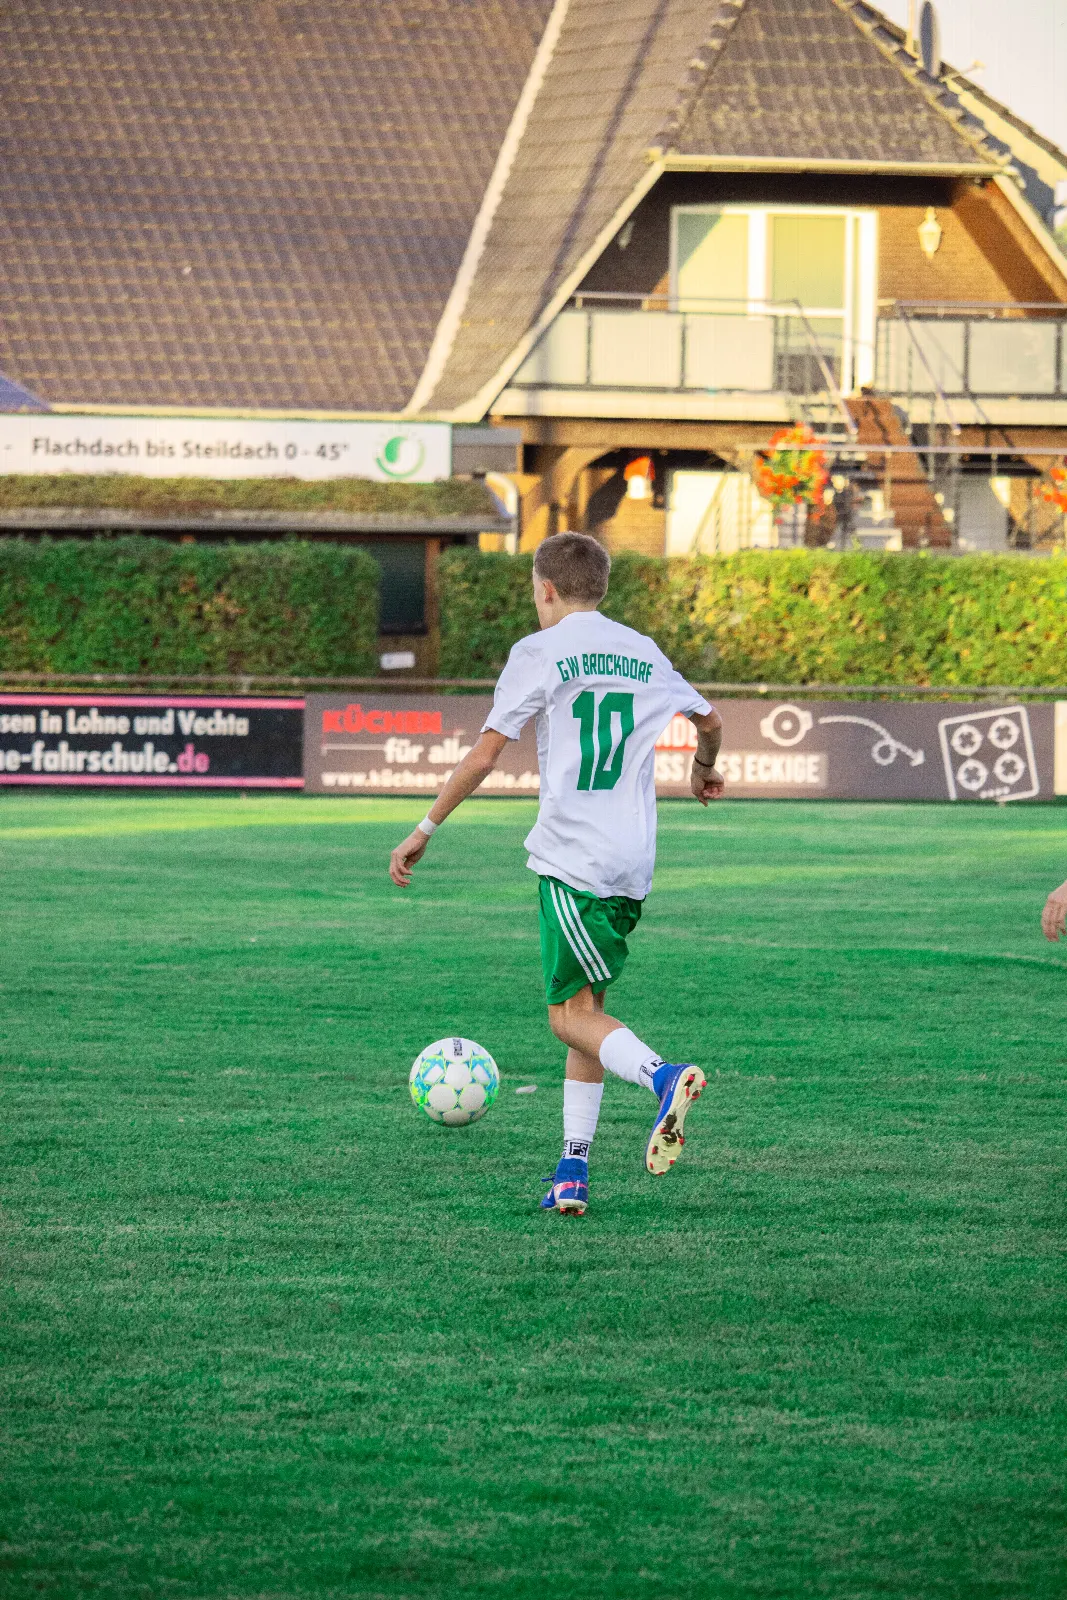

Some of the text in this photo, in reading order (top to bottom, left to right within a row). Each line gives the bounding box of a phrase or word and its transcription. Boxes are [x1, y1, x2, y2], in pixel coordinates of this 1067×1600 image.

[32, 437, 139, 457] Flachdach
[146, 438, 175, 458] bis
[182, 439, 279, 460] Steildach
[285, 442, 298, 461] 0
[556, 653, 654, 683] GW BROCKDORF
[40, 708, 62, 734] in
[66, 707, 130, 735] Lohne
[133, 708, 175, 736] und
[177, 708, 249, 737] Vechta
[322, 704, 442, 734] KÜCHEN
[384, 737, 424, 763] für
[572, 690, 635, 791] 10
[746, 754, 821, 783] ECKIGE
